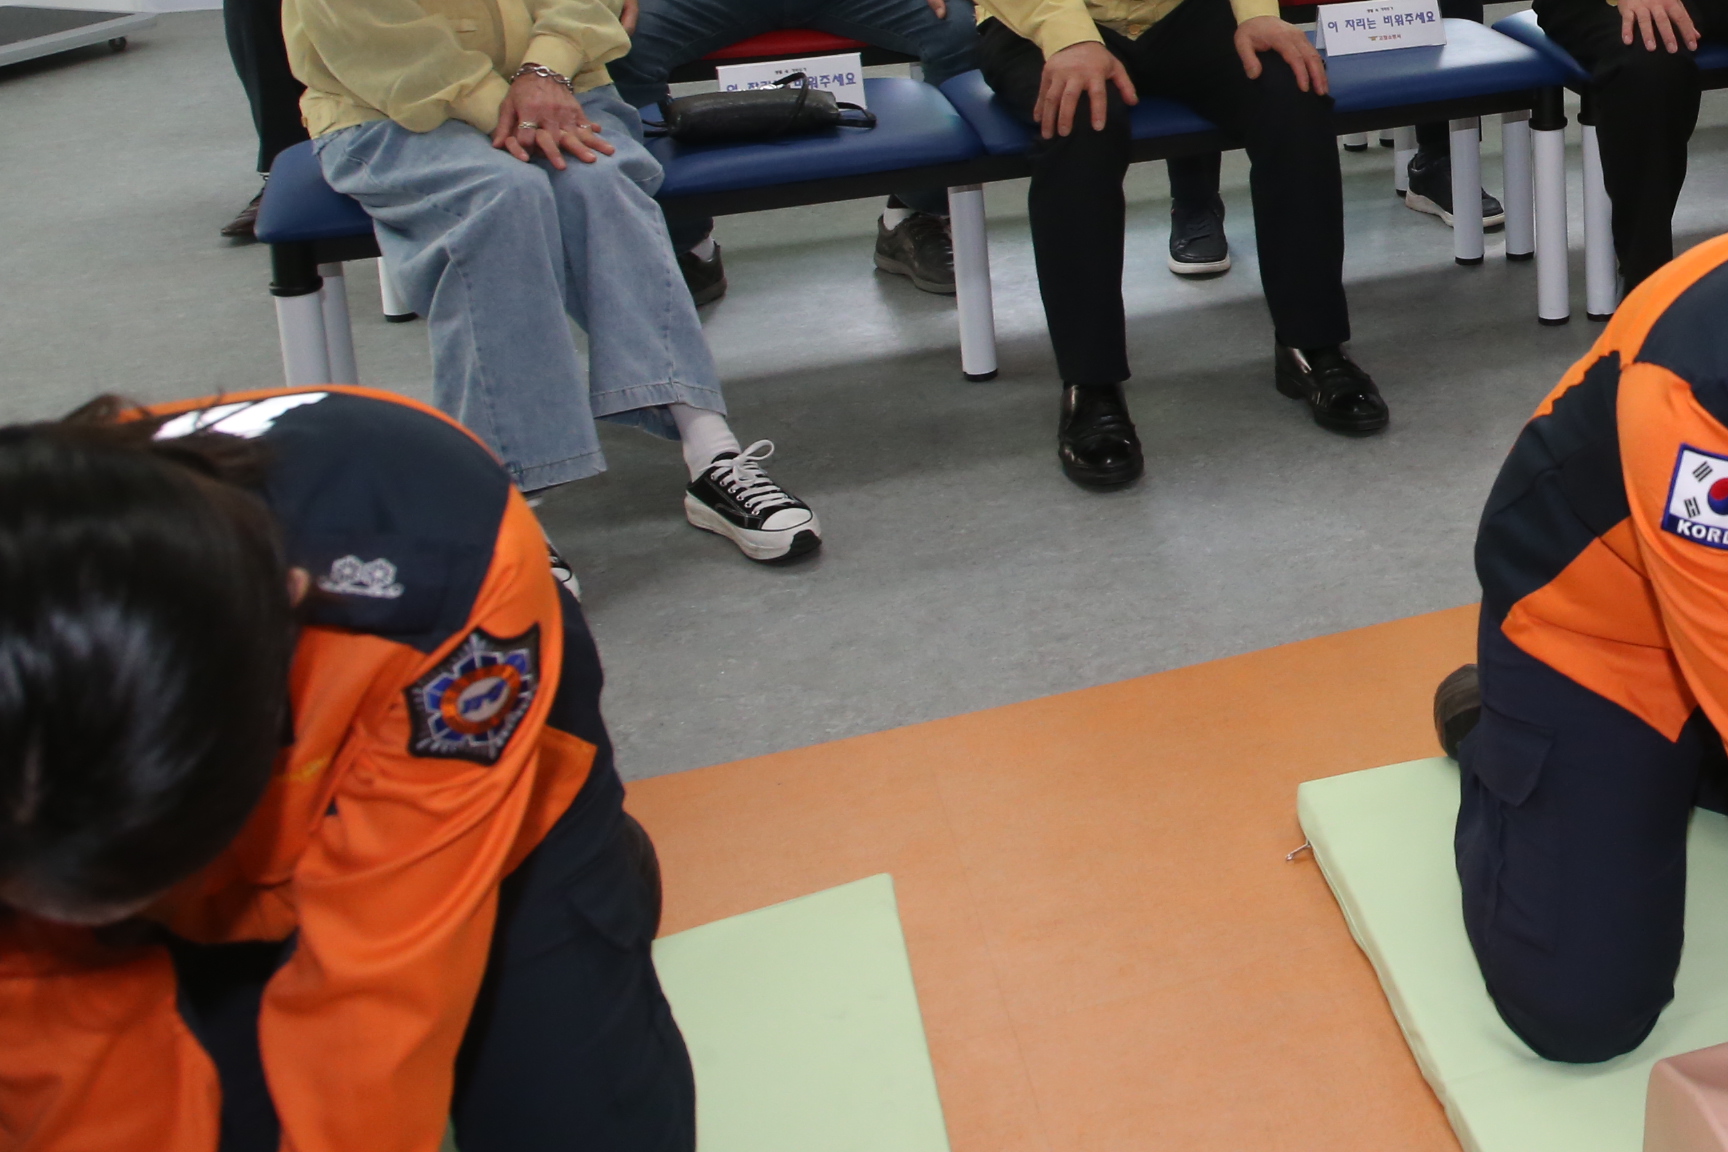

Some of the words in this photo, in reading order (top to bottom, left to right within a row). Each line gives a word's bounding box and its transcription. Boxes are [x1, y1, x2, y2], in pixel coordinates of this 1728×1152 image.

[1328, 21, 1338, 32] 이
[1345, 18, 1376, 30] 자리는
[1384, 11, 1436, 27] 비워주세요
